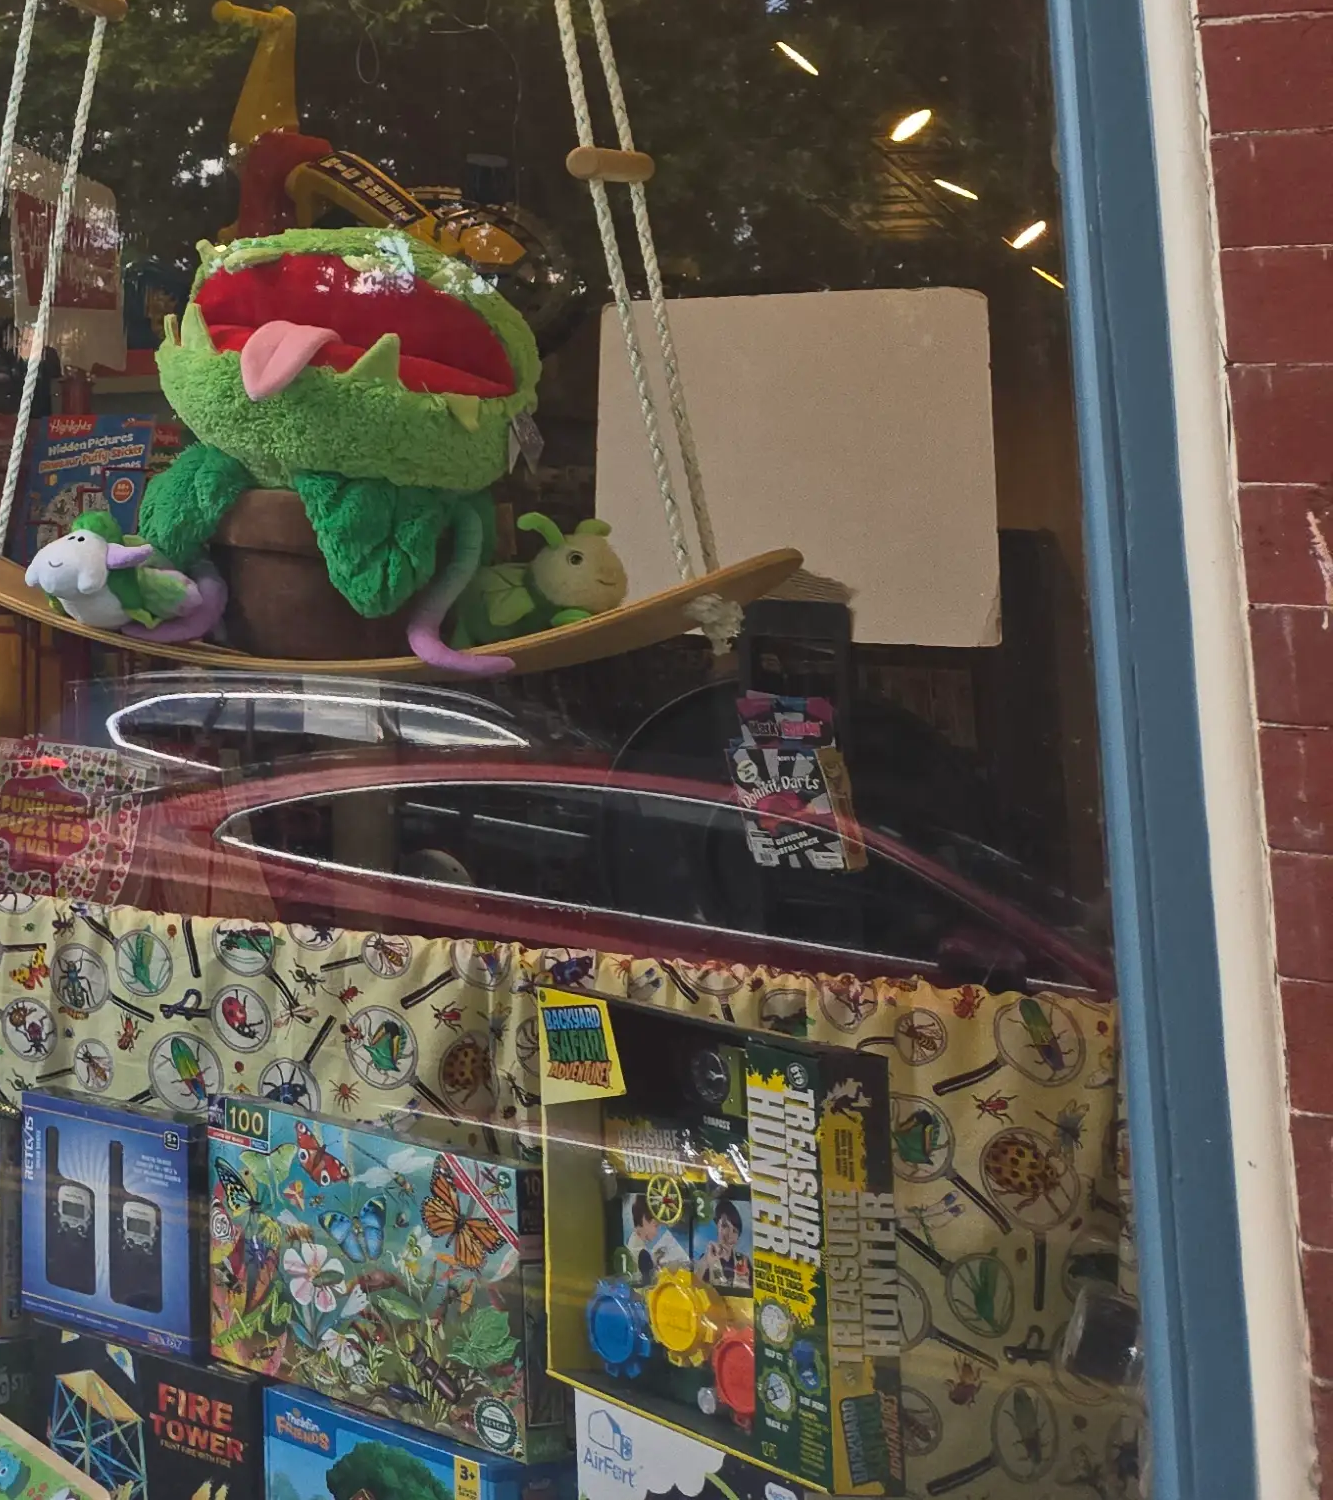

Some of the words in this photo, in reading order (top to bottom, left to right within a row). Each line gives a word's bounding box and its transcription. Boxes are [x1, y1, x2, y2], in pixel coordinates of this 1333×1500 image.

[49, 418, 94, 436] Highlights
[48, 440, 87, 456] Hidden
[87, 432, 135, 449] Pictures
[81, 450, 109, 467] Puffy
[108, 443, 146, 460] Sticker
[781, 775, 821, 791] Darts
[544, 1007, 601, 1030] BACKYARD
[547, 1028, 607, 1061] SAFARI
[547, 1060, 613, 1089] ADVENTURES
[229, 1106, 264, 1136] 100
[746, 1086, 790, 1256] HUNTER
[784, 1086, 821, 1269] TREASURE
[696, 1196, 706, 1218] 2
[826, 1190, 865, 1367] TREASURE
[858, 1192, 901, 1357] HUNTER
[158, 1381, 234, 1432] FIRE
[149, 1412, 245, 1463] TOWER
[275, 1415, 330, 1452] FRIENDS
[160, 1438, 181, 1451] FIGHT
[197, 1449, 215, 1464] WITH
[215, 1454, 232, 1469] FIRE
[583, 1448, 637, 1488] AirFort
[459, 1464, 477, 1482] 3+
